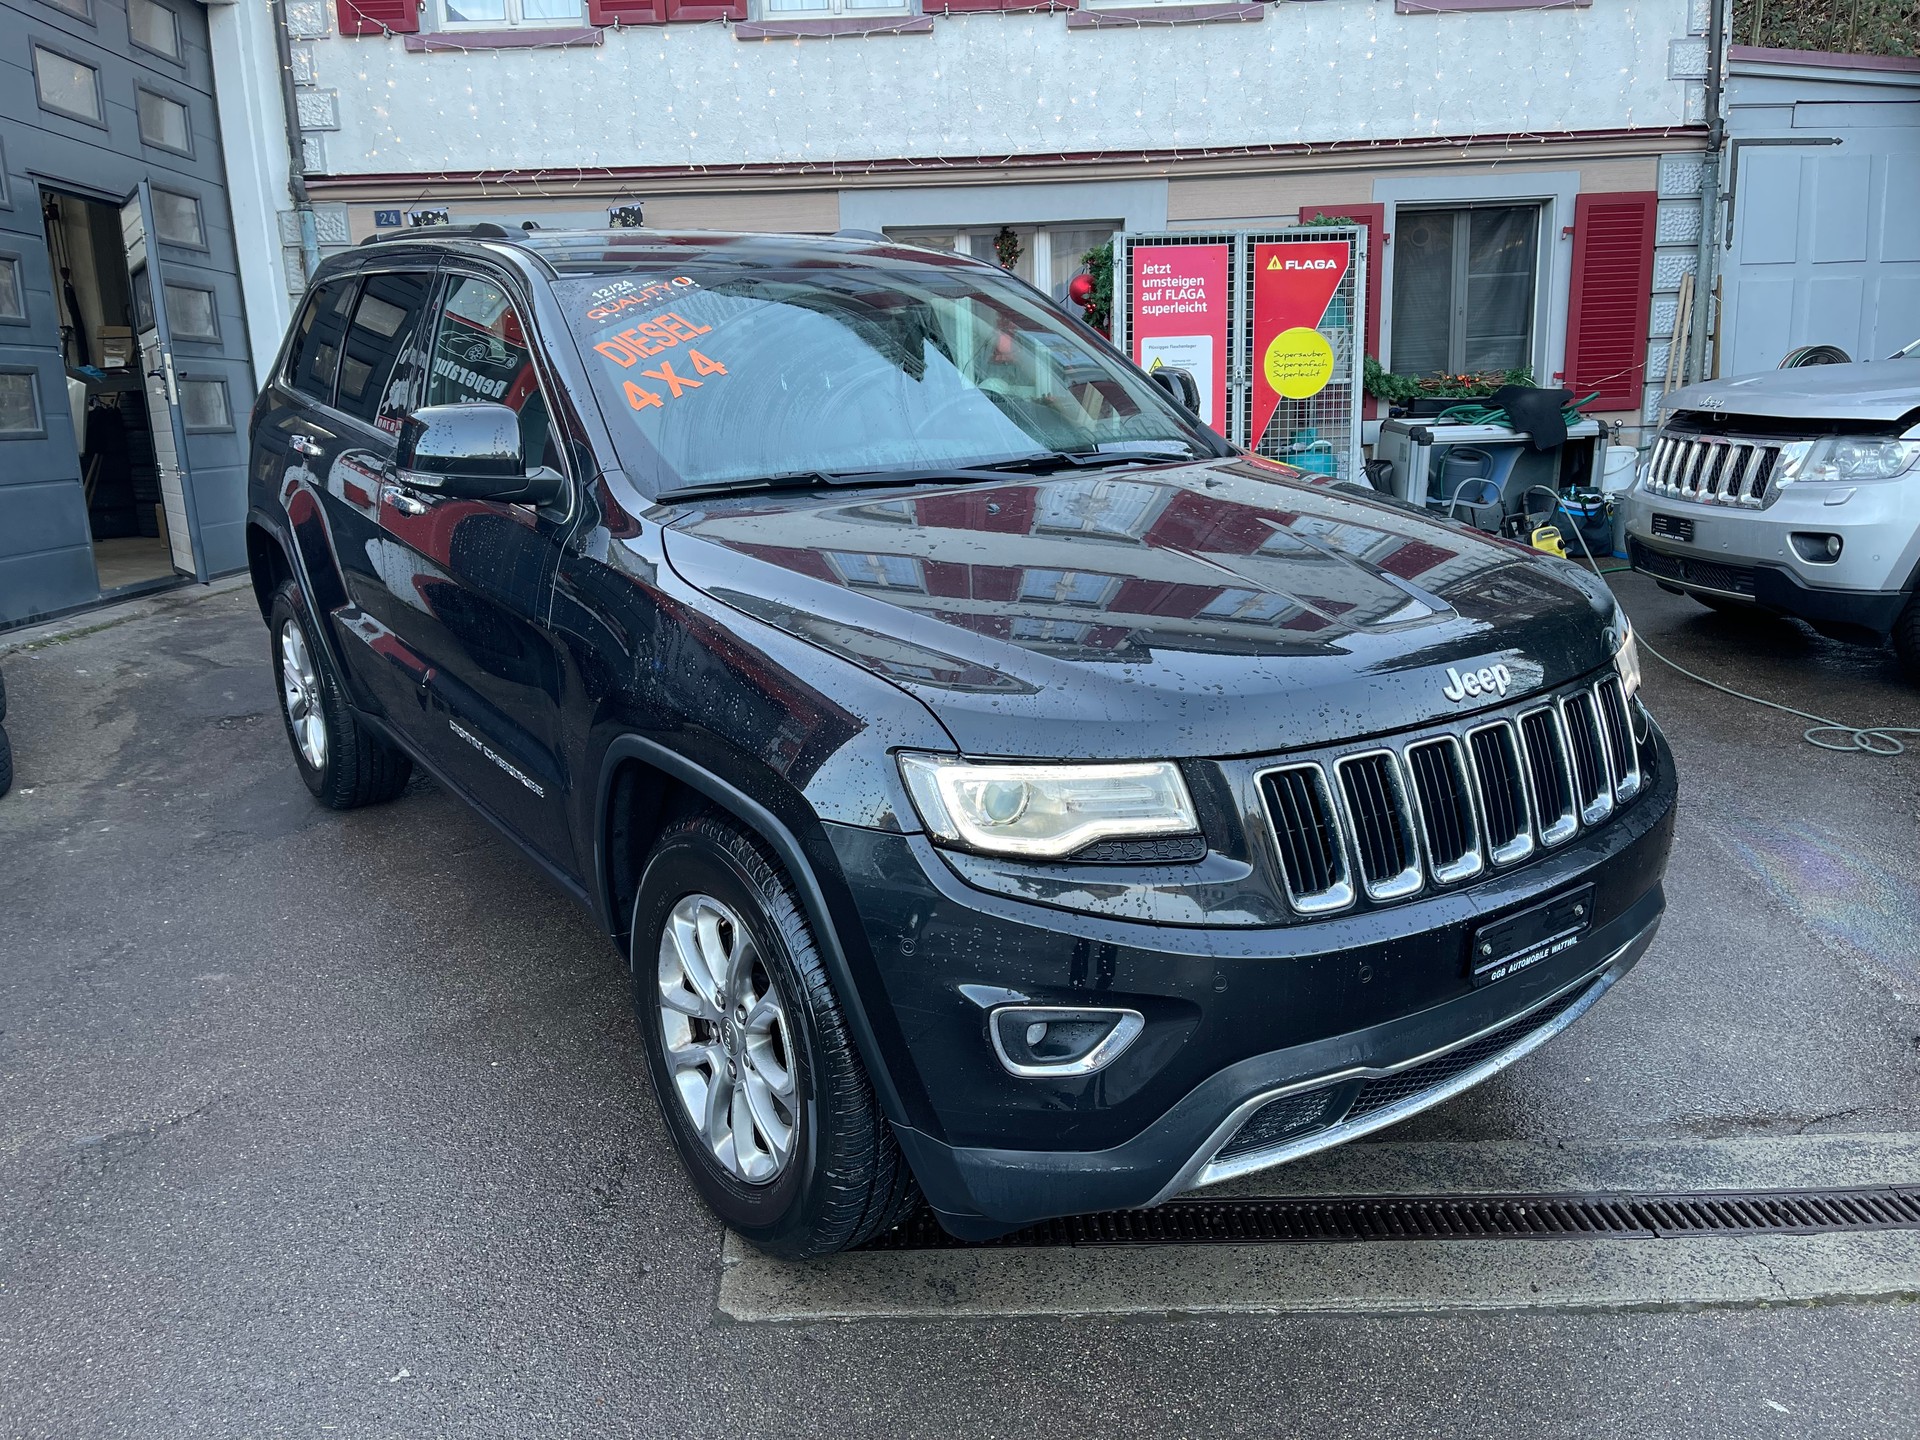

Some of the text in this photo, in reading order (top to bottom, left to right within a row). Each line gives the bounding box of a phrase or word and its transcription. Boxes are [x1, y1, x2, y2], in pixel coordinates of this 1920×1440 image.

[380, 212, 396, 225] 24
[1141, 263, 1172, 275] Jetzt
[1285, 259, 1338, 270] FLAGA
[591, 279, 634, 299] 12/24
[1142, 275, 1205, 290] umsteigen
[587, 281, 672, 320] QUALITY
[1141, 288, 1206, 301] auf FLAGA
[1142, 301, 1208, 317] superleicht
[592, 312, 713, 369] DIESEL
[1273, 350, 1327, 360] Supersauber
[1273, 360, 1328, 370] Supereinfach
[1273, 369, 1320, 380] Superleicht
[1442, 664, 1512, 702] Jeep
[1491, 967, 1507, 981] GGB
[1507, 948, 1550, 974] AUTOMOBILE
